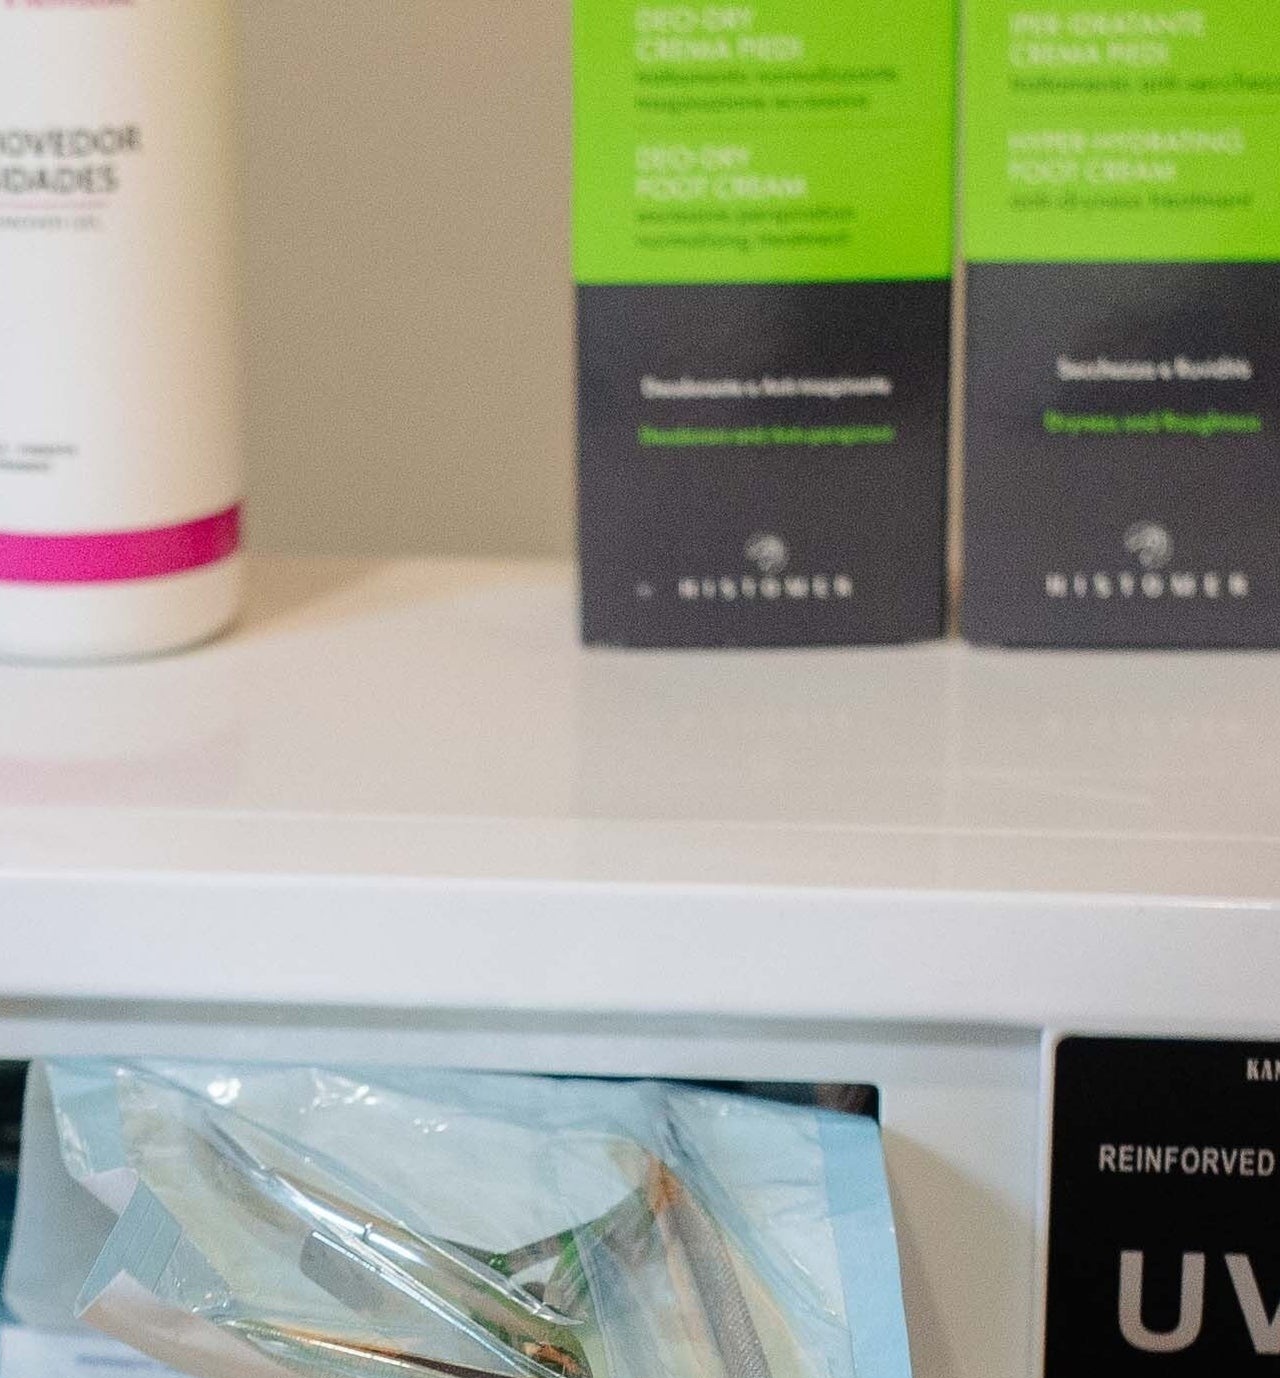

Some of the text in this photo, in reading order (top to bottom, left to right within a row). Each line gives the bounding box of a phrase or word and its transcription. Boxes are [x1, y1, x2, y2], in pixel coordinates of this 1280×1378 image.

[677, 574, 854, 600] HISTOMER
[1045, 572, 1251, 600] HISTOMER
[1099, 1144, 1274, 1177] REINFORVED
